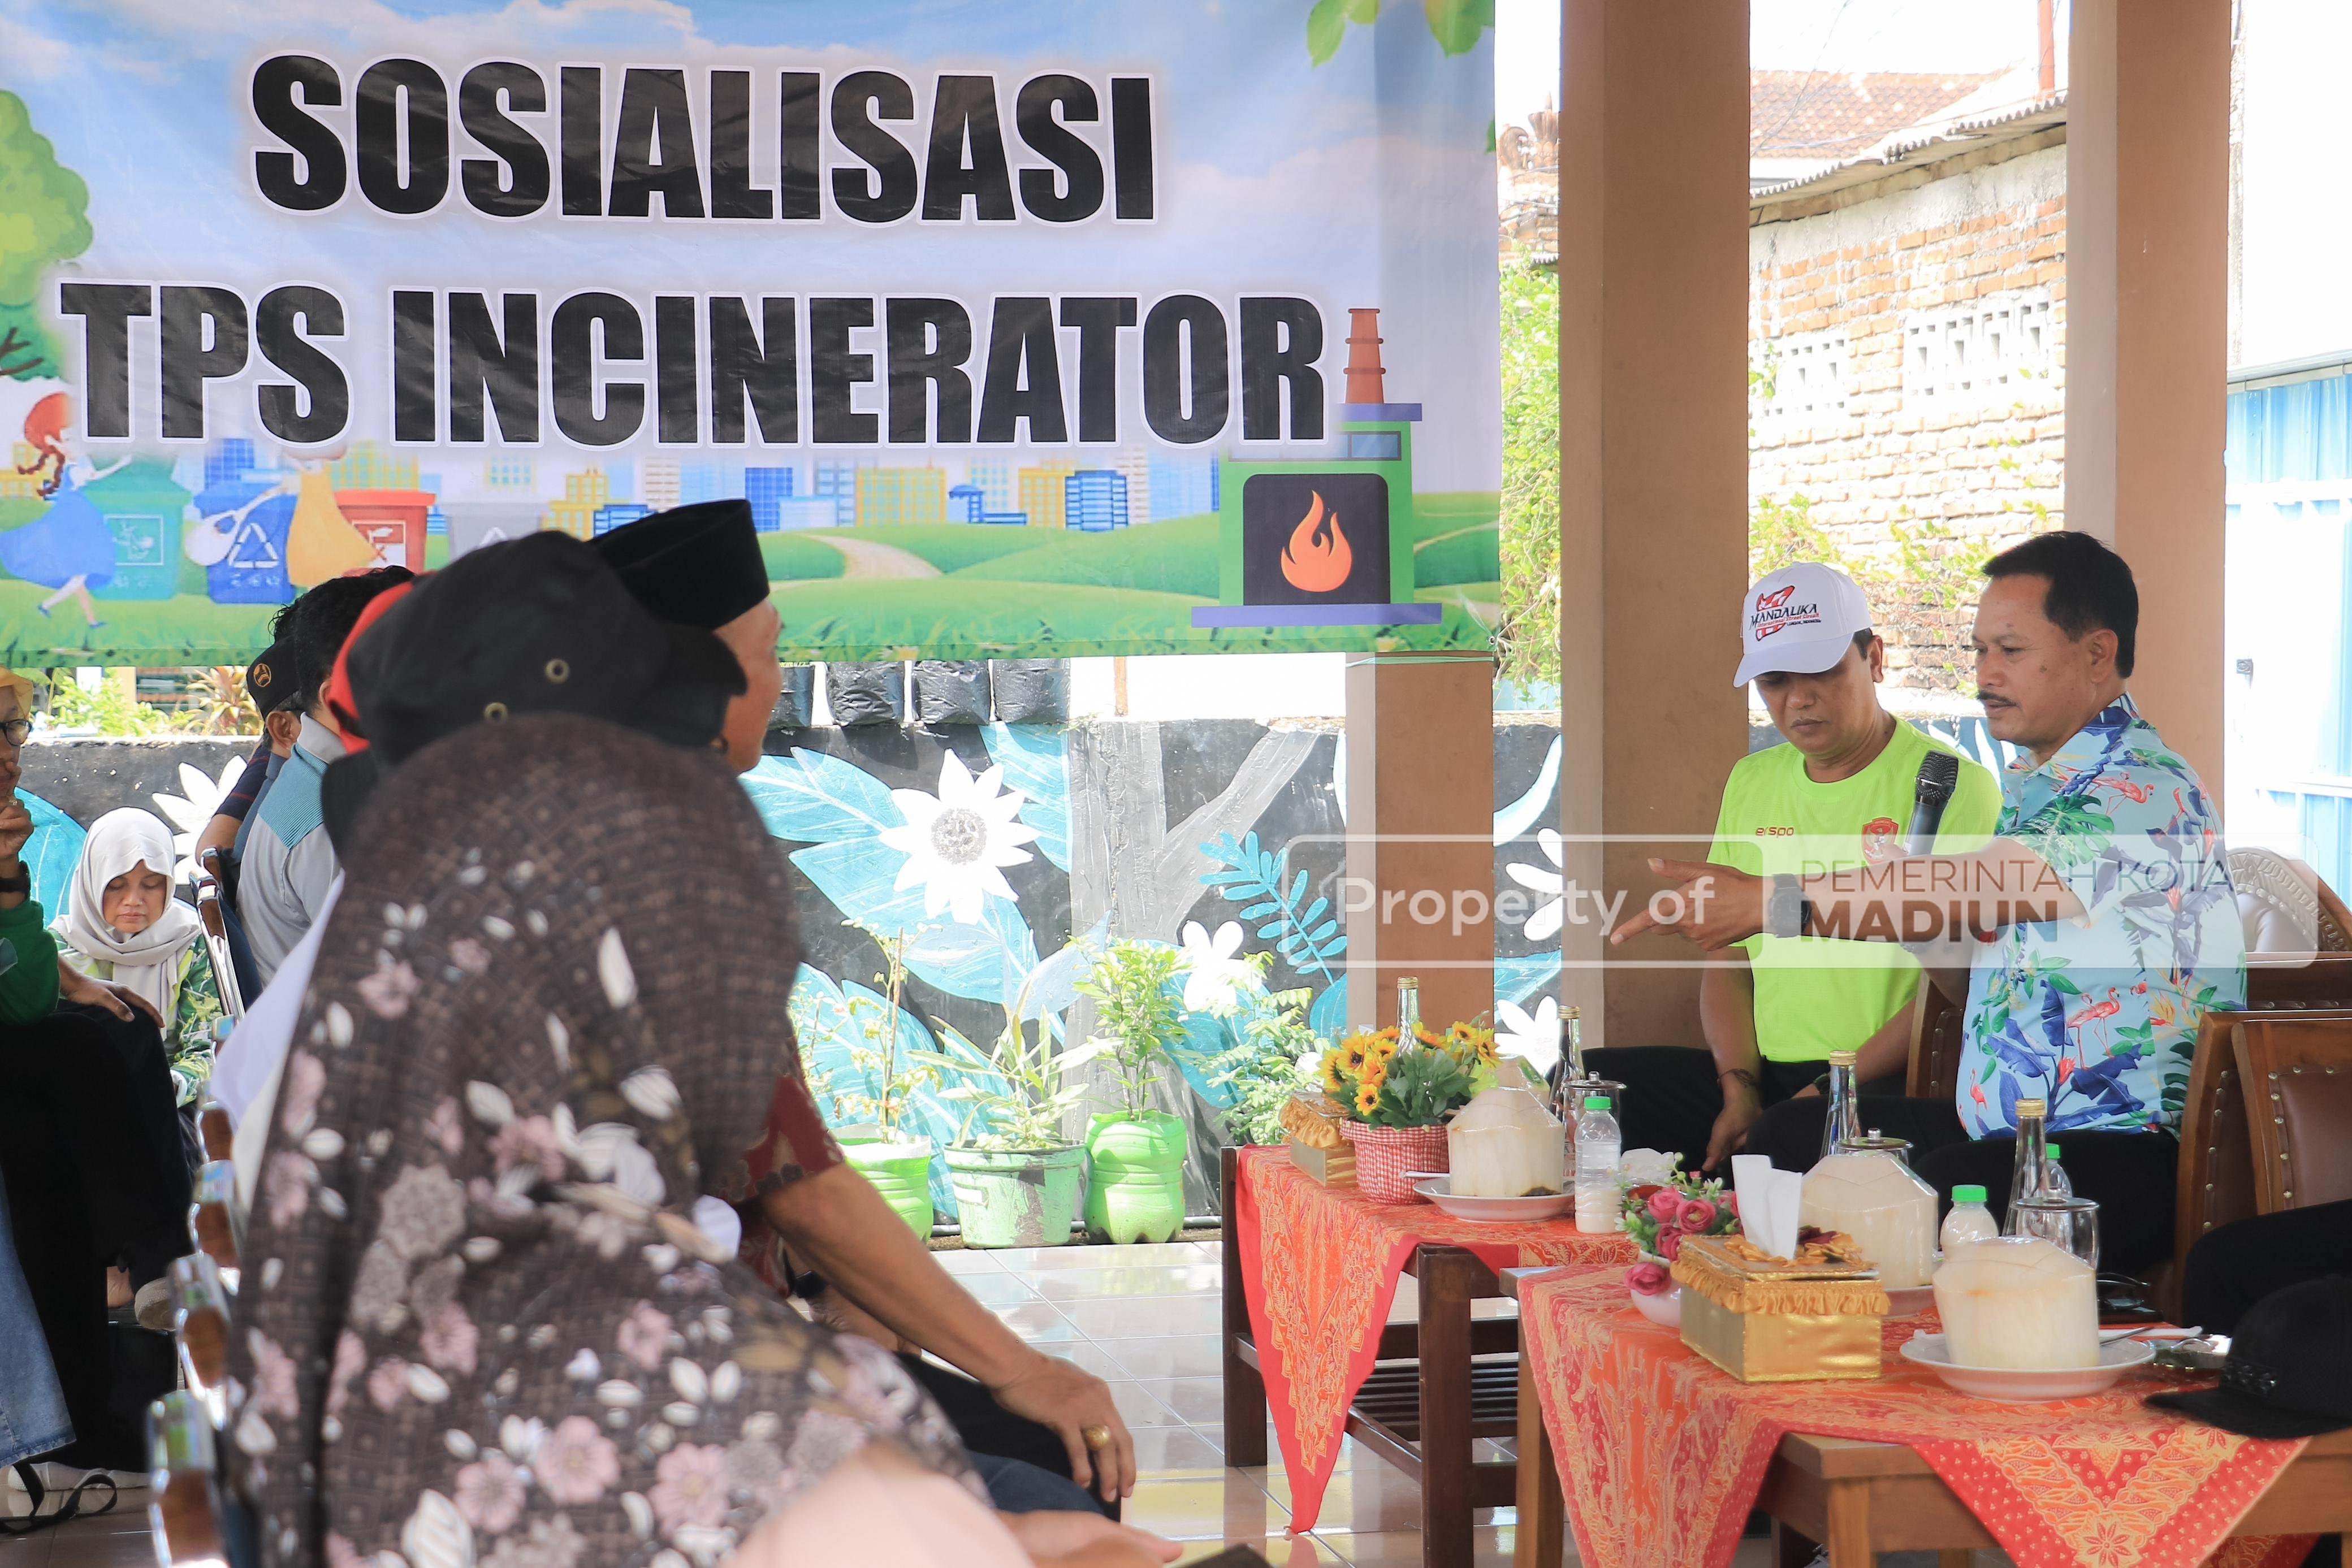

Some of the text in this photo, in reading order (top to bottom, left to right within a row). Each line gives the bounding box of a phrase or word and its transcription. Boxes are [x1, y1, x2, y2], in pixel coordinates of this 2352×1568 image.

[252, 54, 1154, 223] SOSIALISASI
[60, 283, 1325, 446] TPS INCINERATOR
[1749, 604, 1817, 630] MANDALIKA
